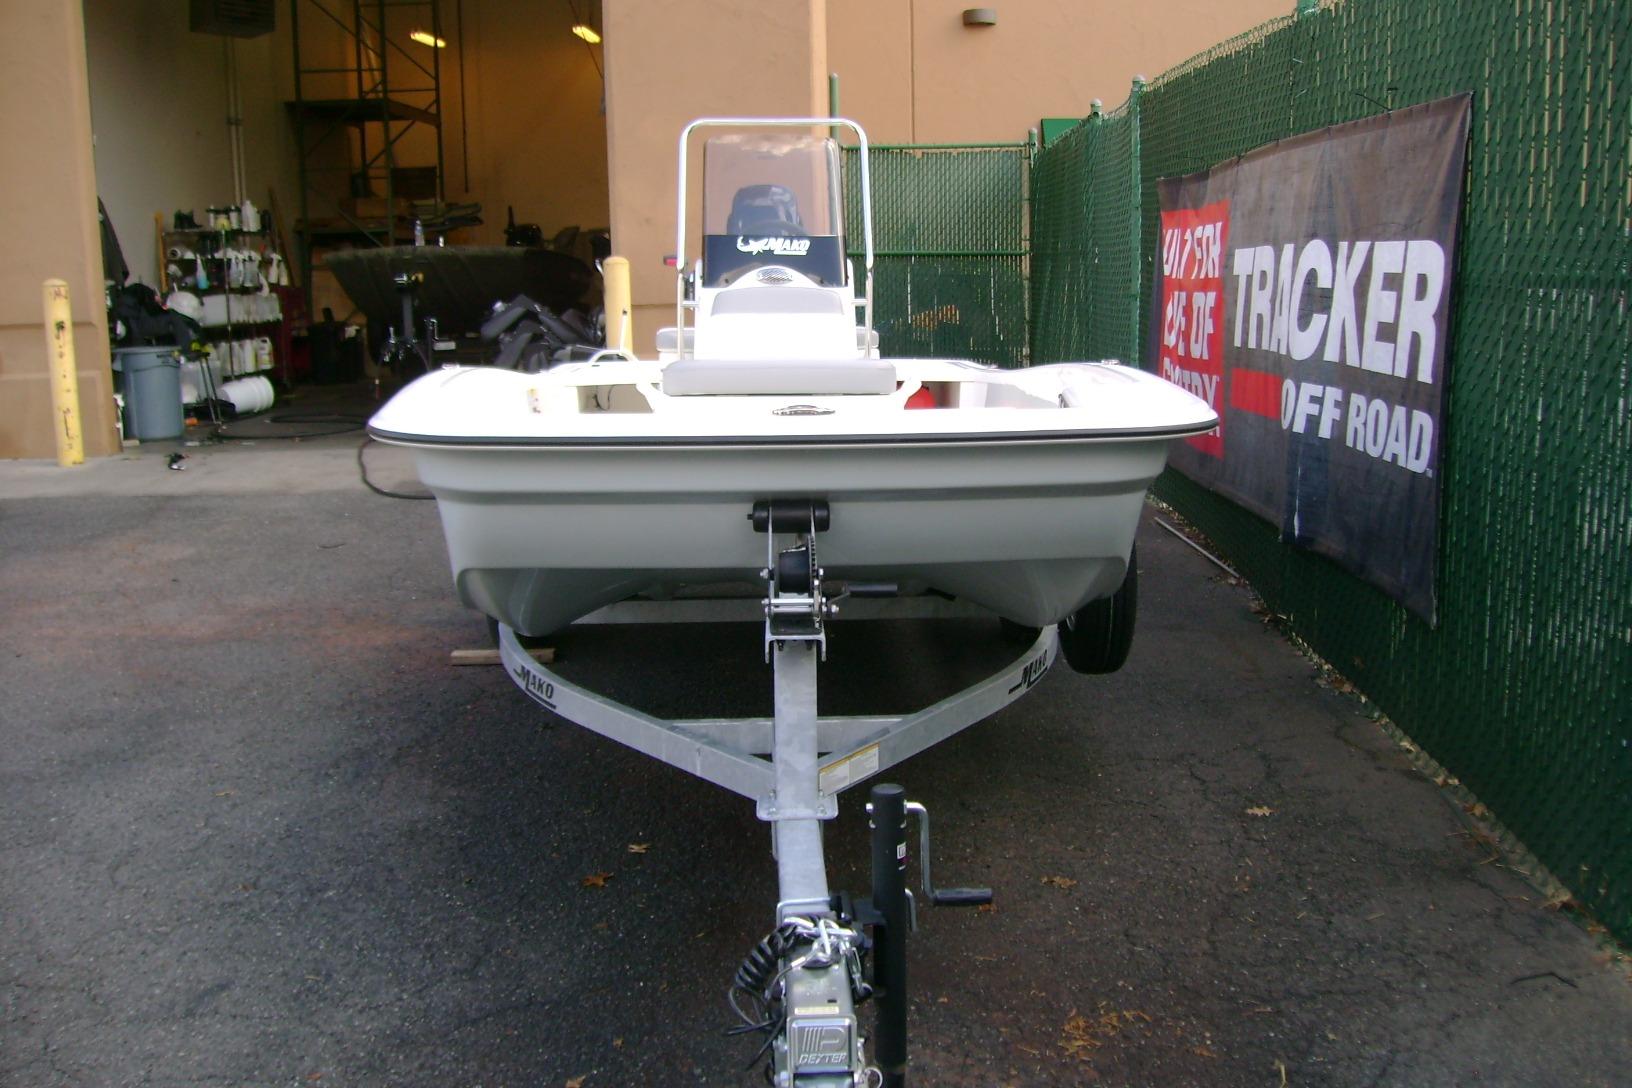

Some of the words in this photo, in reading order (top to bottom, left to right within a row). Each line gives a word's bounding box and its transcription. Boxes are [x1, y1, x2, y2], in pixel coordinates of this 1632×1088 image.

[1190, 291, 1217, 360] OF
[1233, 239, 1445, 384] TRACKER
[1281, 378, 1343, 440] OFF
[1346, 392, 1433, 474] ROAD
[518, 664, 555, 703] MAKO
[799, 1052, 847, 1065] DEXTER
